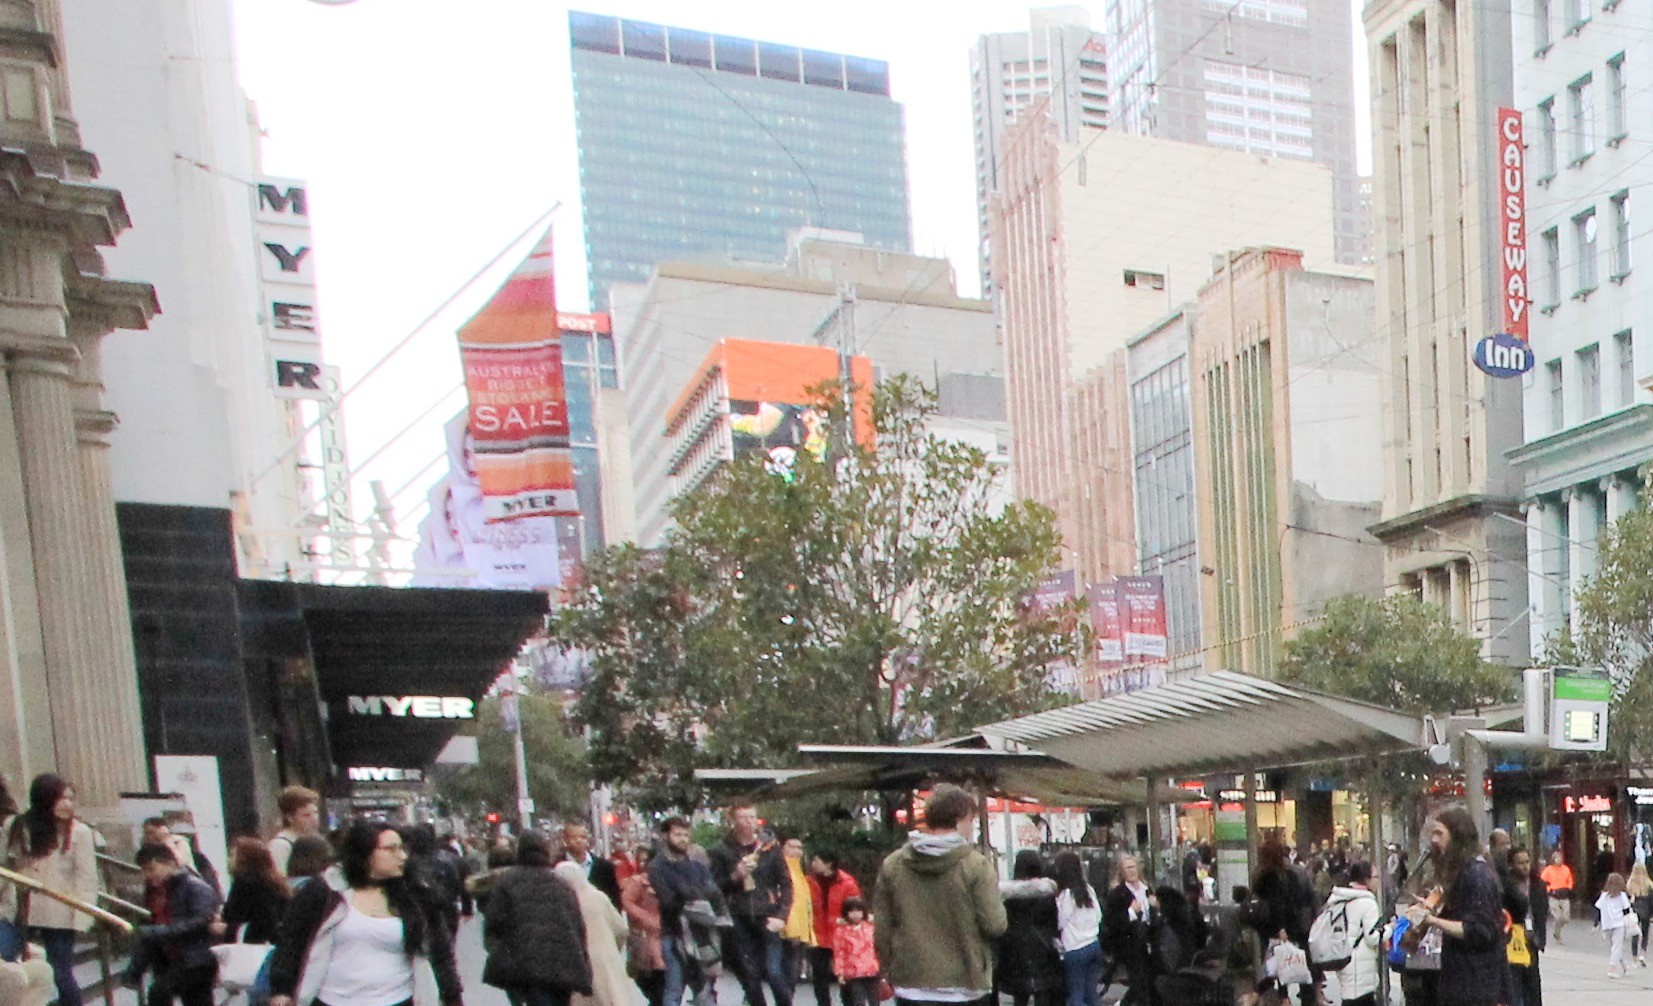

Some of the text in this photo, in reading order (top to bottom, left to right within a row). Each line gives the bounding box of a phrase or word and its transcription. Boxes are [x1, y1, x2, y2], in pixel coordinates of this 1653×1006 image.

[1502, 116, 1526, 323] CAUSEWAY
[258, 184, 321, 390] MYER
[557, 317, 598, 330] POST
[1484, 339, 1526, 370] Inn
[474, 401, 563, 432] SALE
[348, 695, 474, 719] MYER
[348, 767, 422, 781] MYER
